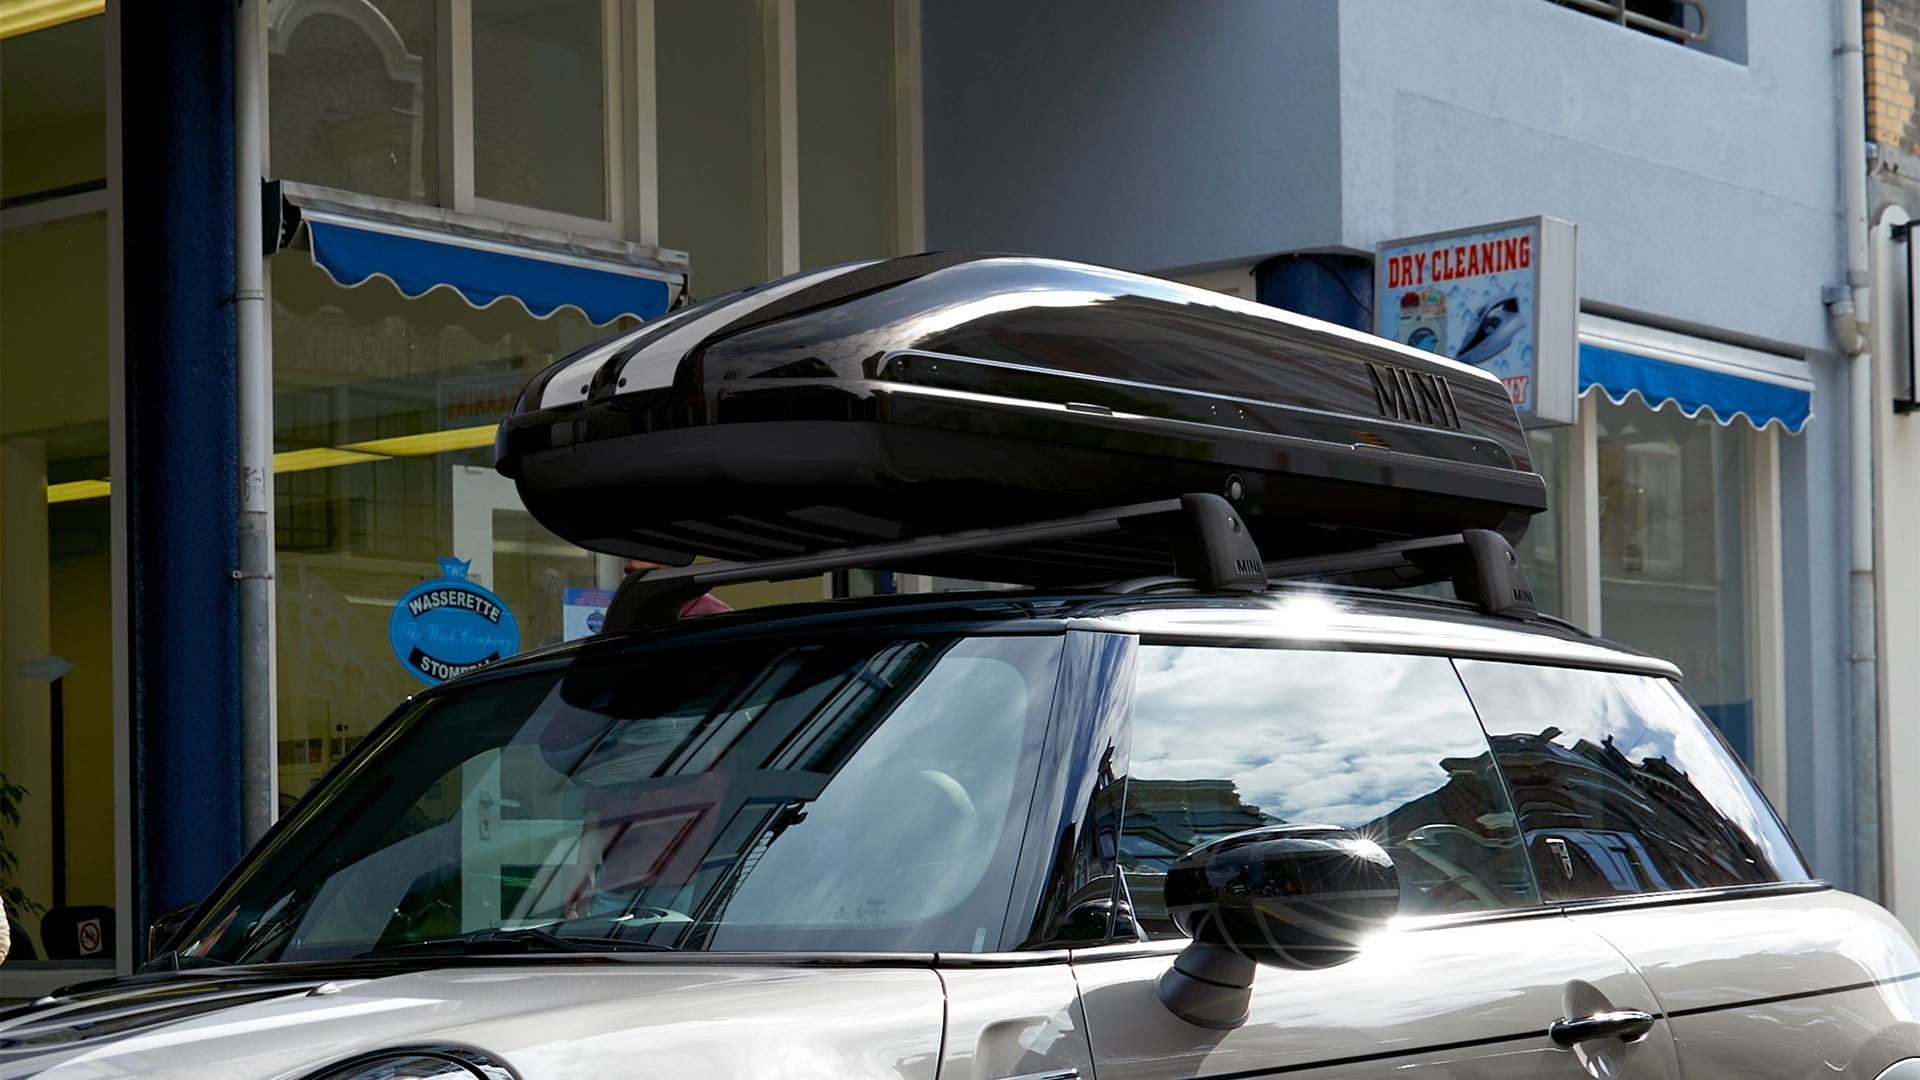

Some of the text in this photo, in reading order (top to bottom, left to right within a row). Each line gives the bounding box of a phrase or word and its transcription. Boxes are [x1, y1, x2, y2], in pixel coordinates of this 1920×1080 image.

[1388, 236, 1531, 289] DRY CLEANING
[1364, 362, 1461, 429] MINI
[445, 564, 466, 577] TWC
[1235, 560, 1262, 575] MINI
[409, 590, 500, 623] WASSERETTE
[397, 621, 513, 652] The Wash Company
[421, 656, 491, 679] STOME
